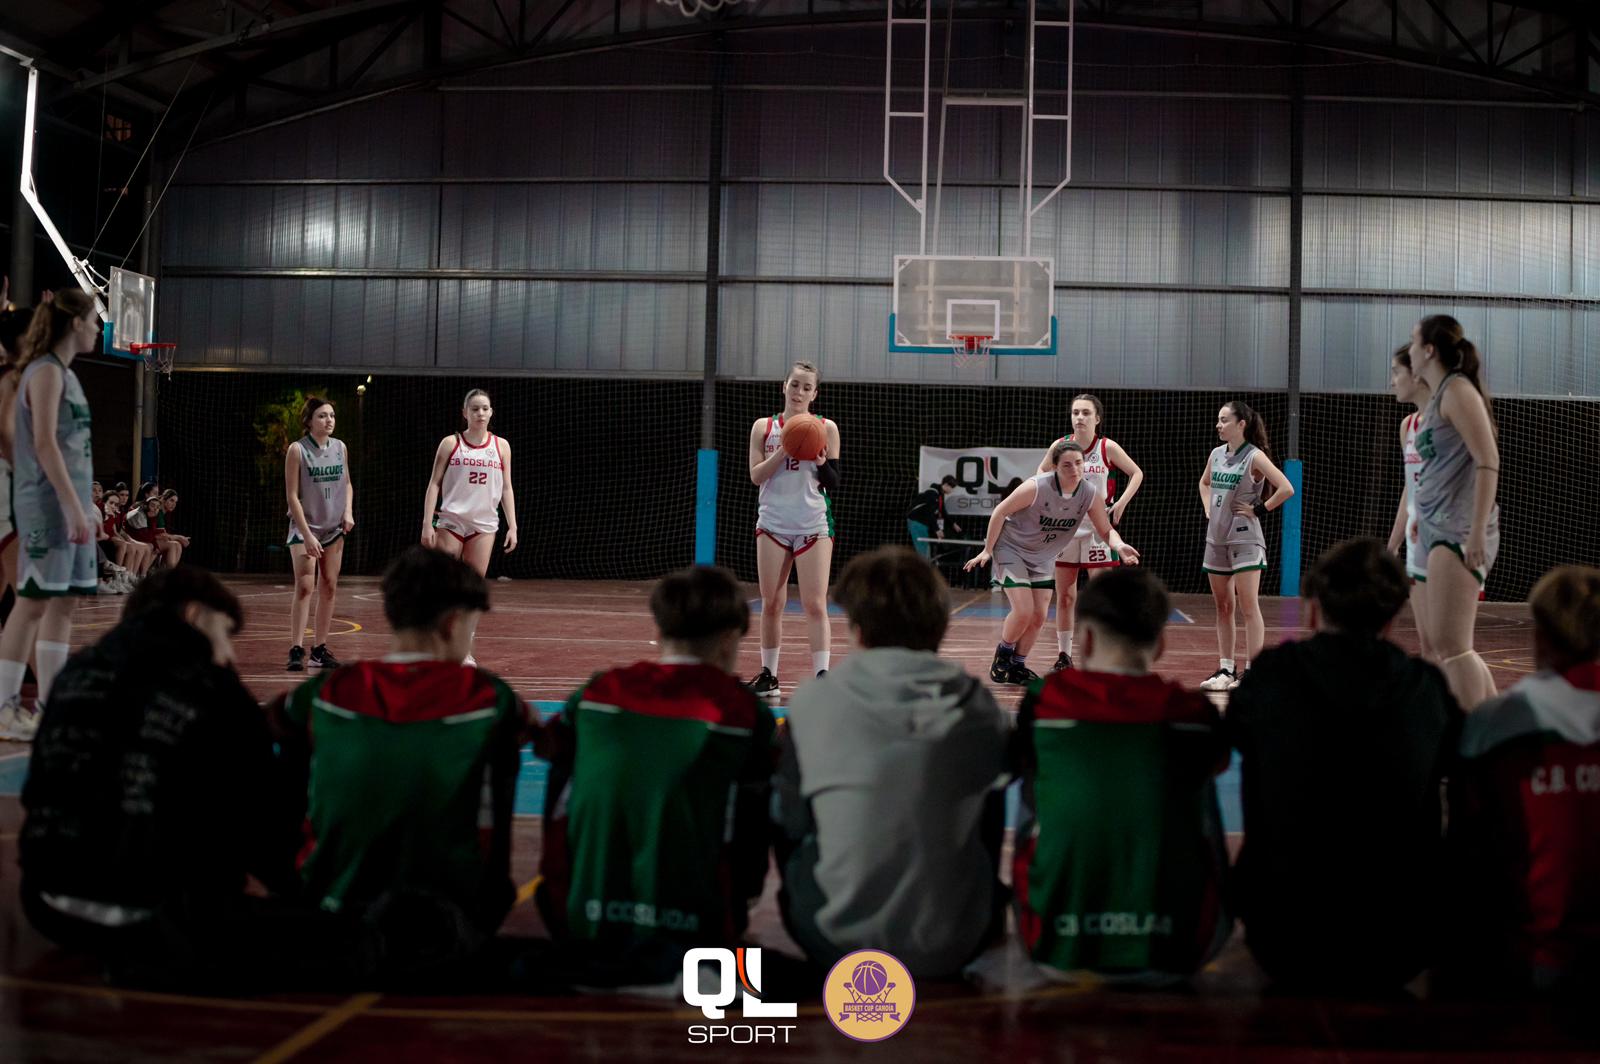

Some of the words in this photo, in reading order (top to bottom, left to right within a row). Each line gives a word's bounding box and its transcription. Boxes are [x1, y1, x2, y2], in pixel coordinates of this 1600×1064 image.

[449, 458, 460, 466] CB
[786, 458, 800, 470] 12
[308, 465, 343, 476] VALCUDE
[957, 457, 1007, 494] QL
[469, 472, 487, 485] 22
[324, 488, 331, 499] 11
[1217, 495, 1222, 508] 8
[1040, 516, 1077, 528] VALCUD
[1089, 550, 1106, 561] 23
